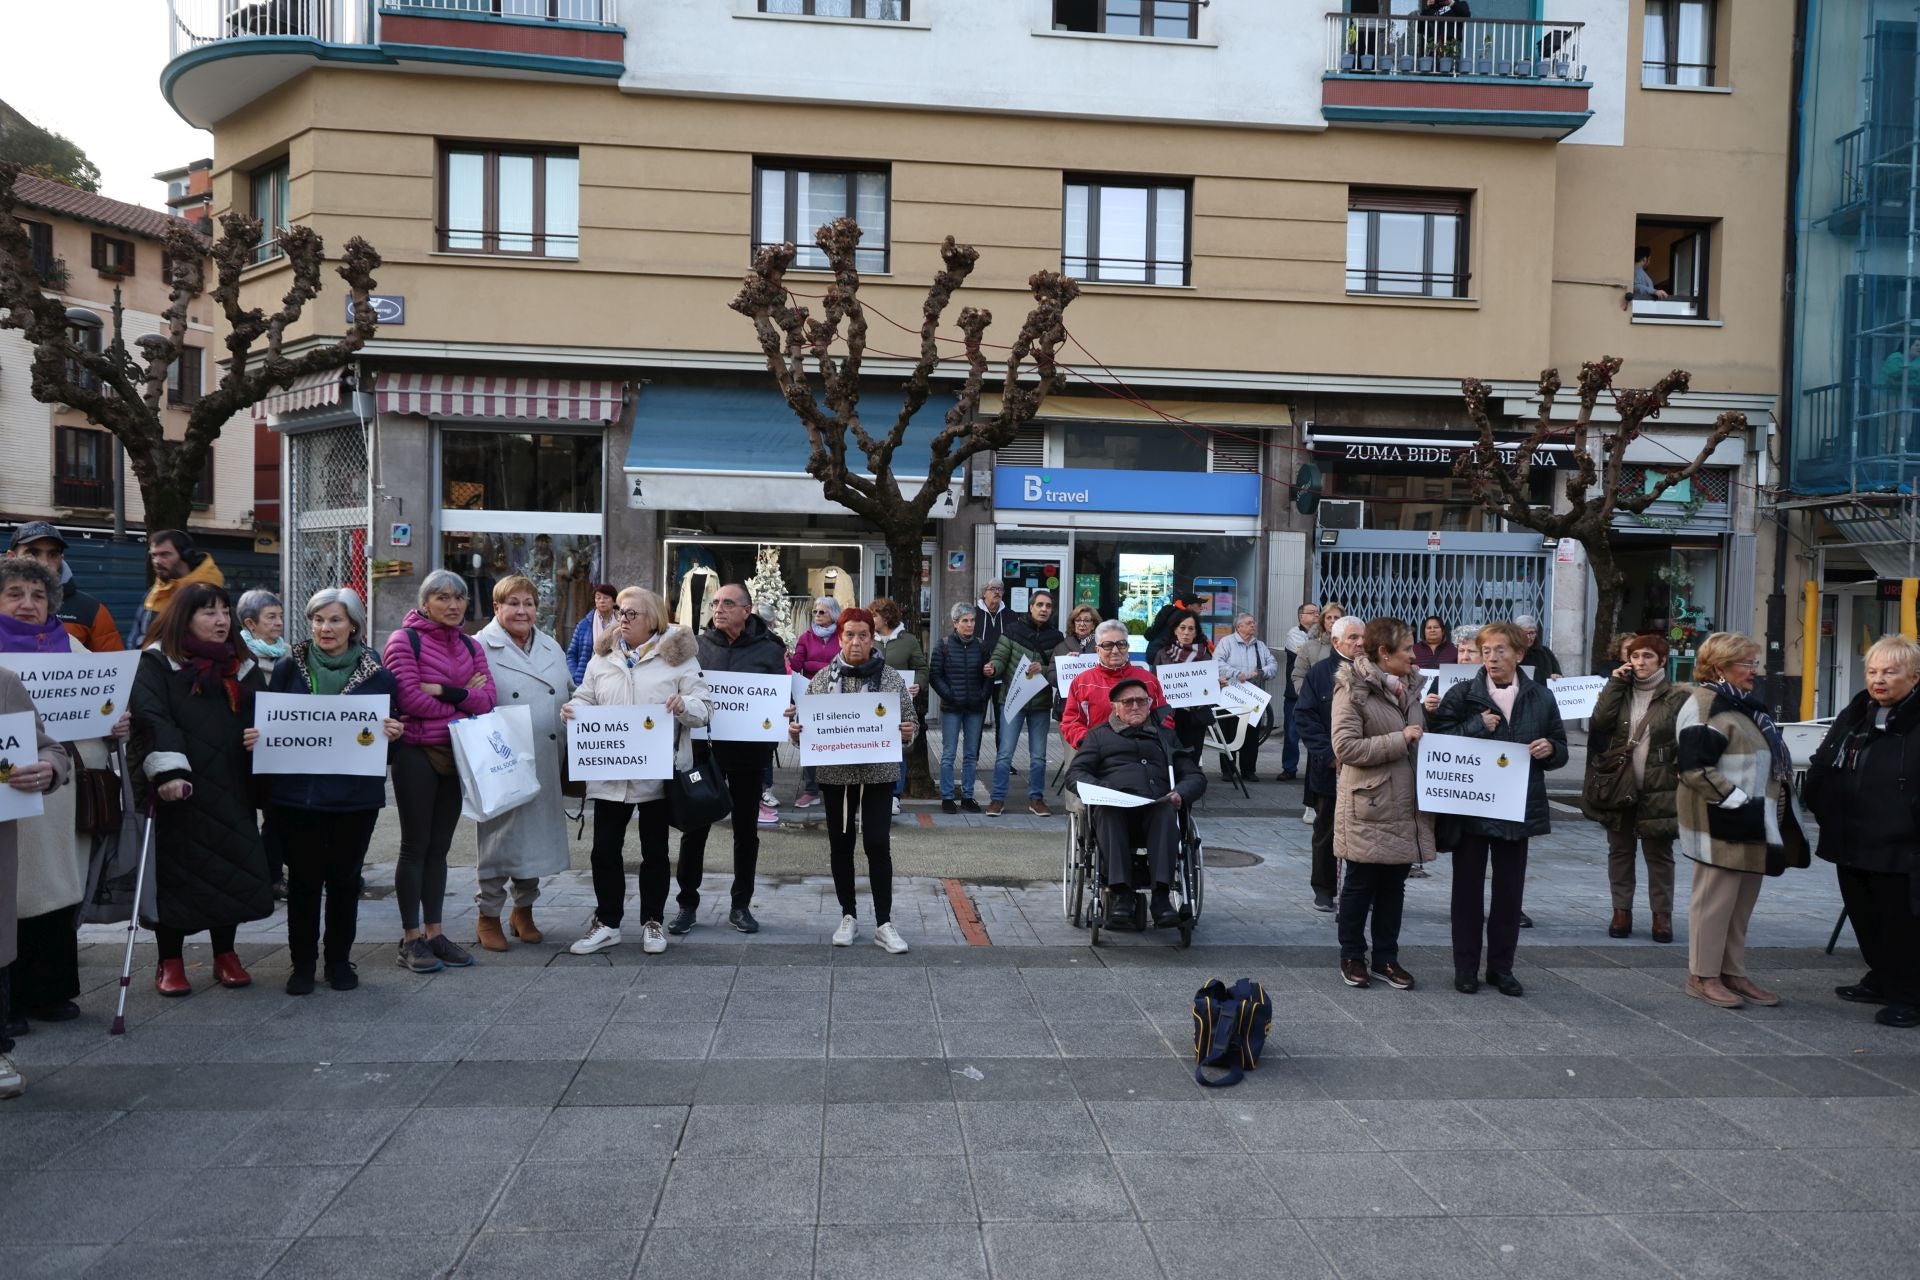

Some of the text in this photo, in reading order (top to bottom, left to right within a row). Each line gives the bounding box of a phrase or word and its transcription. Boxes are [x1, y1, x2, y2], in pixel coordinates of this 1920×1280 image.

[1346, 444, 1557, 466] ZUMA BIDE TBENA
[1024, 475, 1089, 503] B travel
[21, 668, 118, 681] LA VIDA DE LAS
[1162, 672, 1172, 680] ¡NI
[1175, 671, 1190, 679] UNA
[81, 686, 100, 696] NO
[103, 684, 115, 694] ES
[748, 687, 778, 696] GARA
[1165, 692, 1192, 700] MENOS!
[268, 710, 378, 722] ¡JUSTICIA PARA
[813, 712, 860, 722] ¡El silencio
[576, 721, 629, 734] ¡NO MÁS
[817, 724, 883, 735] también mata!
[266, 737, 332, 747] LEONOR!
[577, 740, 626, 750] MUJERES
[811, 742, 879, 752] Zigorgabetasunik
[578, 756, 647, 766] ASESINADAS!
[1427, 751, 1481, 766] ¡NO MÁS
[1426, 770, 1474, 783] MUJERES
[1426, 787, 1496, 802] ASESINADAS!
